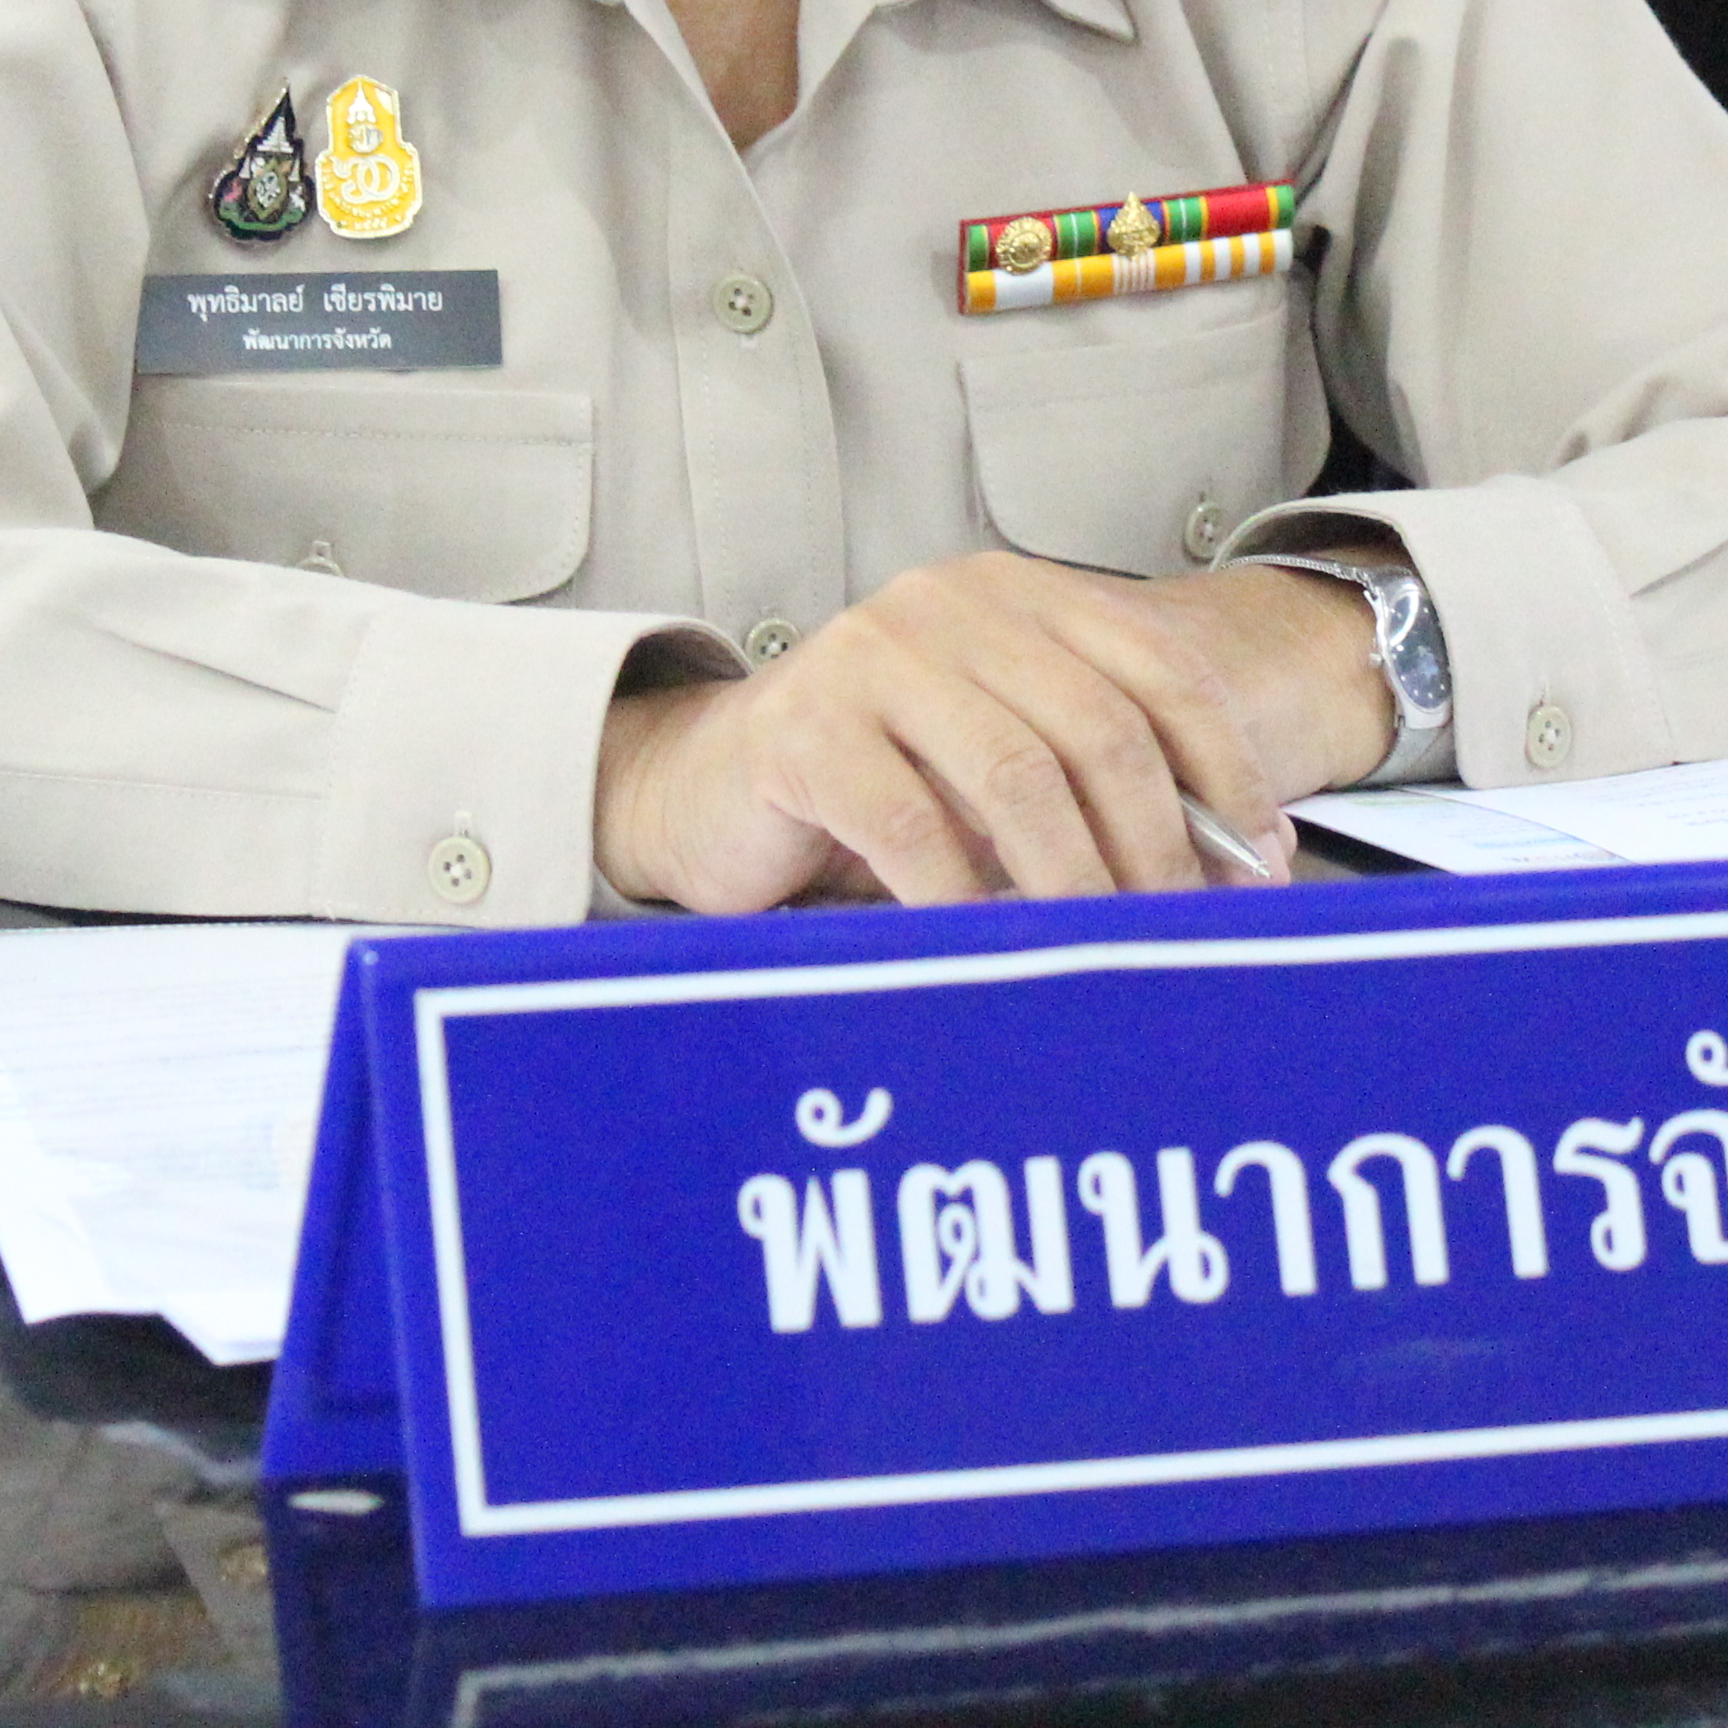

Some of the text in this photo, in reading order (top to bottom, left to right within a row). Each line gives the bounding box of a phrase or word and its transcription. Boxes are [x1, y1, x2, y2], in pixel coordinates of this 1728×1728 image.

[187, 283, 305, 323] พุทธิมาลย์
[242, 327, 393, 351] พัฒนาการจังหวัด
